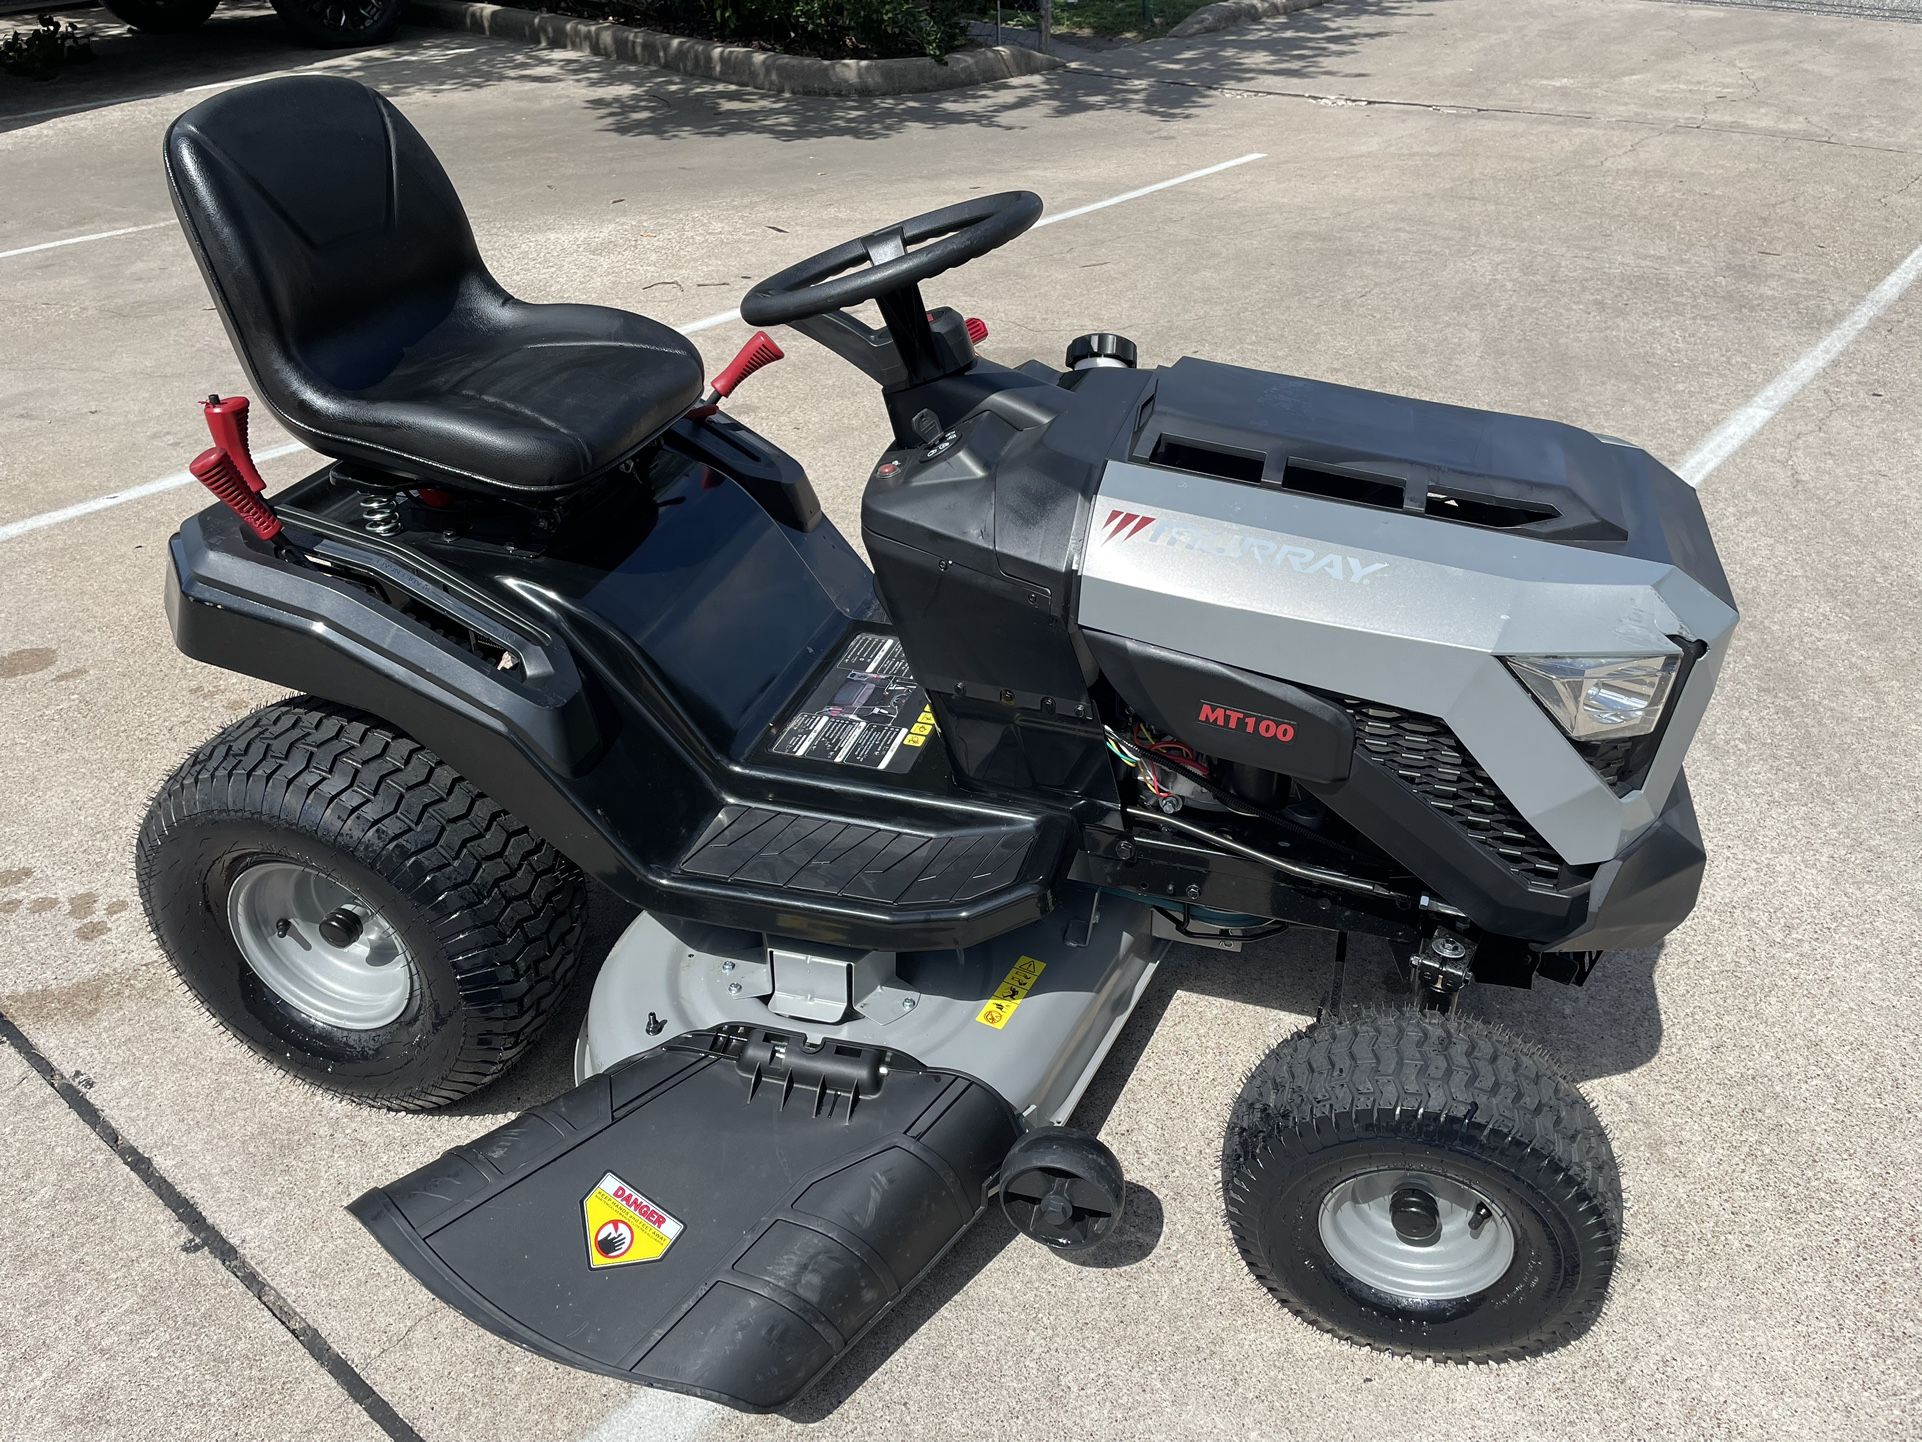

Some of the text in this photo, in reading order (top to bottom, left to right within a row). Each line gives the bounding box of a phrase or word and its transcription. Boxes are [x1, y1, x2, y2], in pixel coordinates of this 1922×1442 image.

[1148, 521, 1389, 582] MURRAY
[1198, 704, 1295, 742] MT100
[597, 1191, 666, 1243] KEEP HANDS and FEET AWAY
[613, 1186, 667, 1229] DANGER
